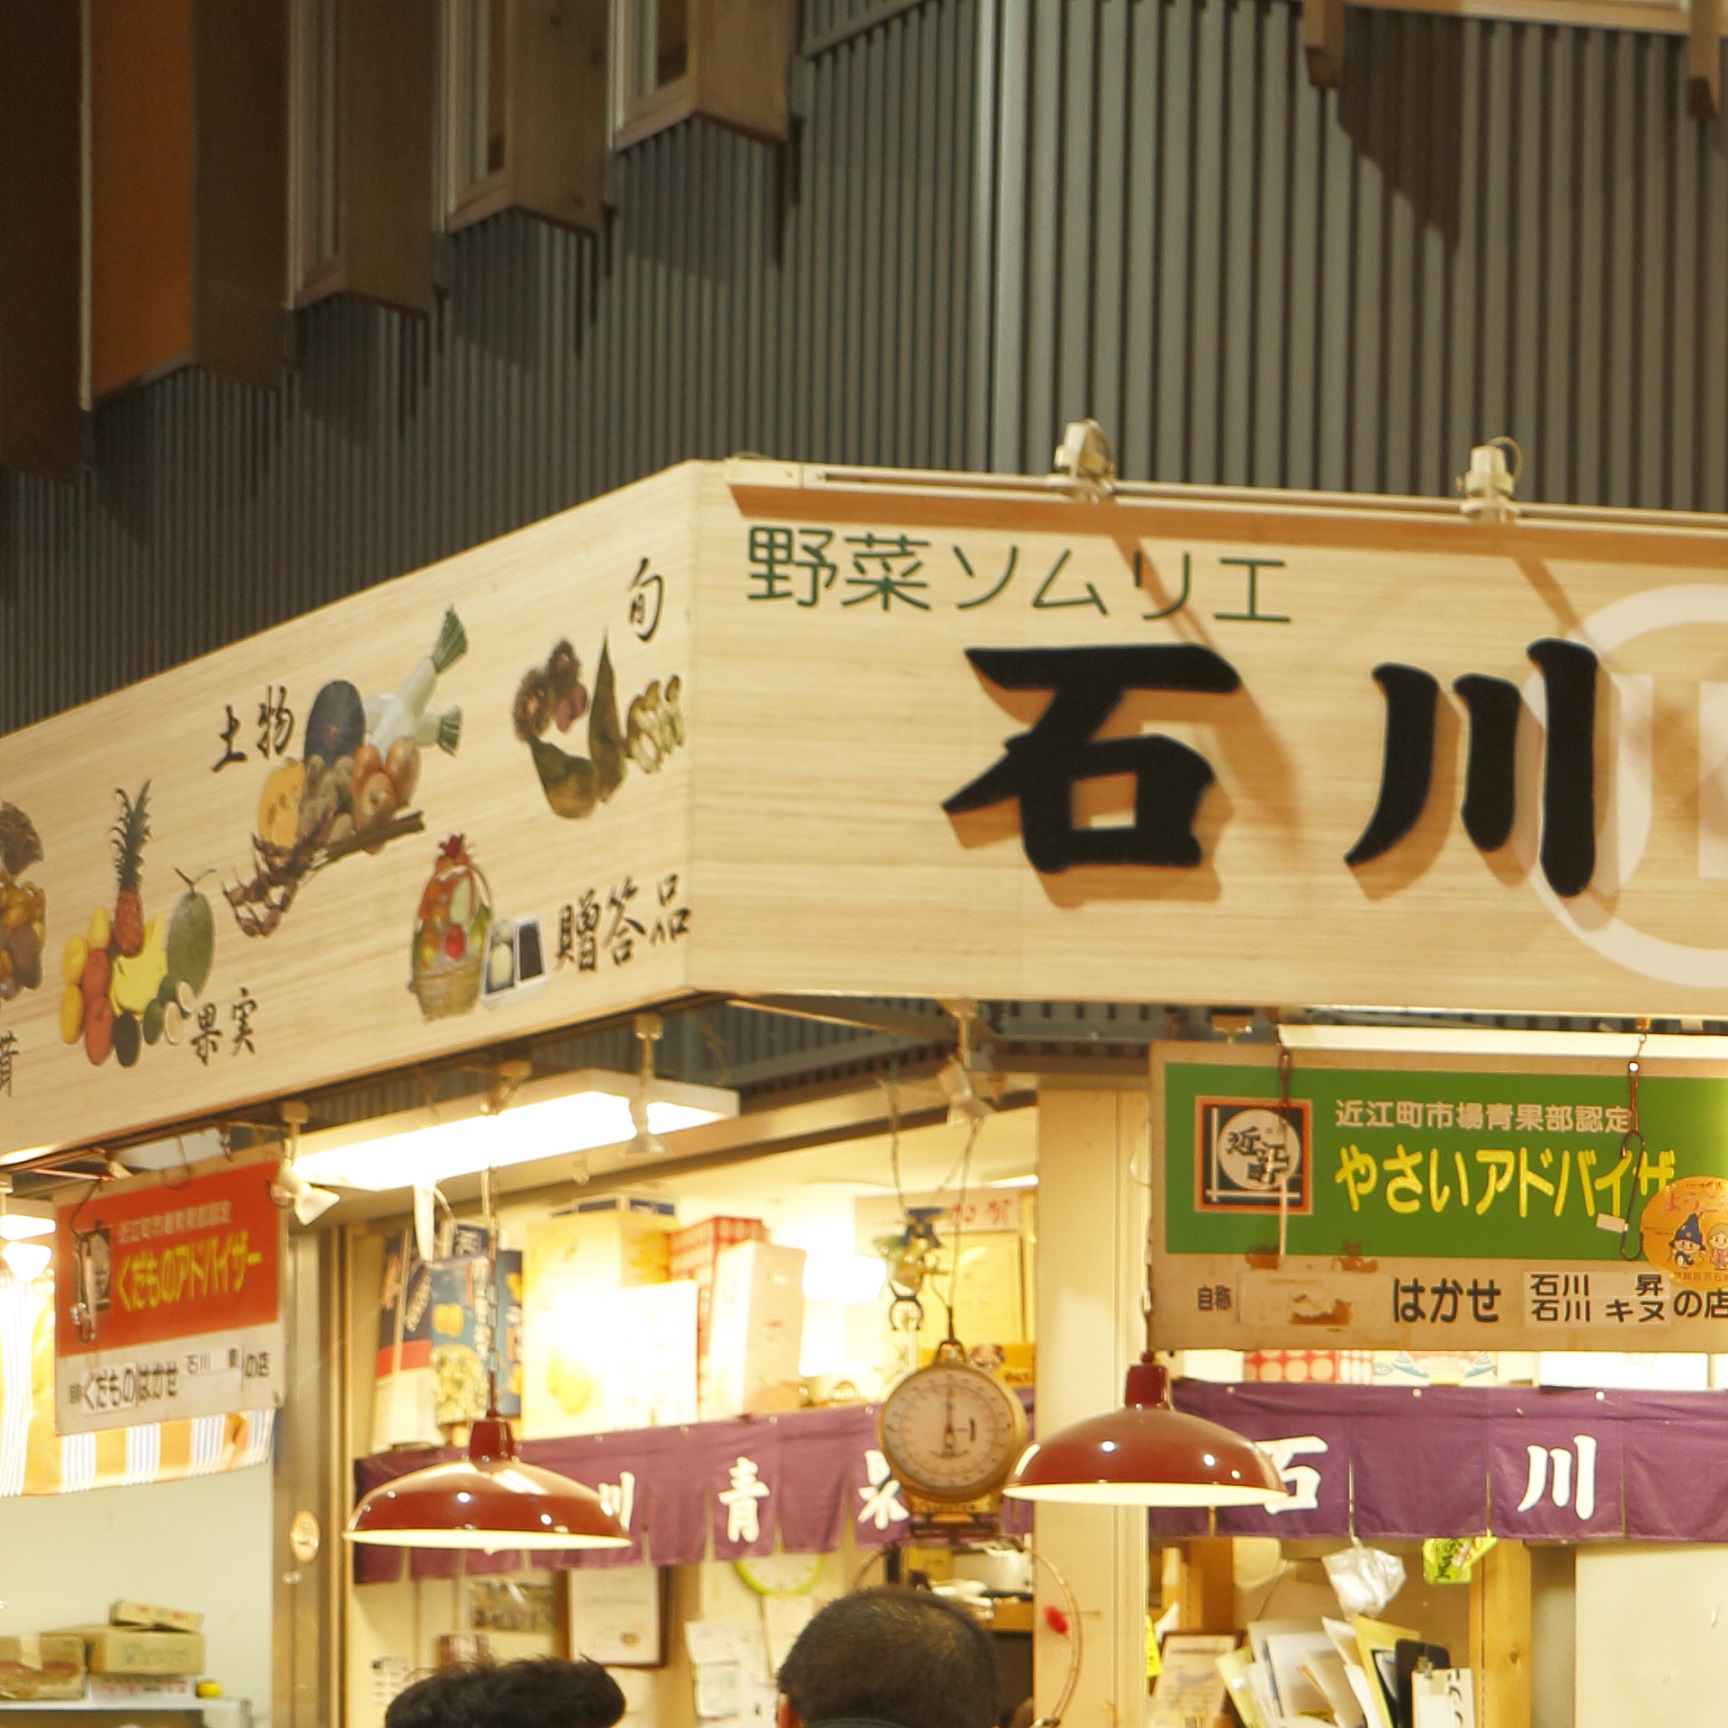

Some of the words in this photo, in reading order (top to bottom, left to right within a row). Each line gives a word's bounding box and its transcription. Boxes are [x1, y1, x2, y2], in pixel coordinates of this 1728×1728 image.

[627, 557, 664, 642] 旬
[747, 525, 1292, 623] 野菜ソムリエ
[211, 685, 294, 772] 土物
[555, 873, 692, 973] 贈答品
[189, 988, 258, 1065] 果実
[1393, 1278, 1501, 1323] はかせ
[1531, 1275, 1590, 1297] 石川
[1635, 1273, 1664, 1297] 昇
[1531, 1299, 1592, 1322] 石川
[1606, 1299, 1665, 1323] キヌ
